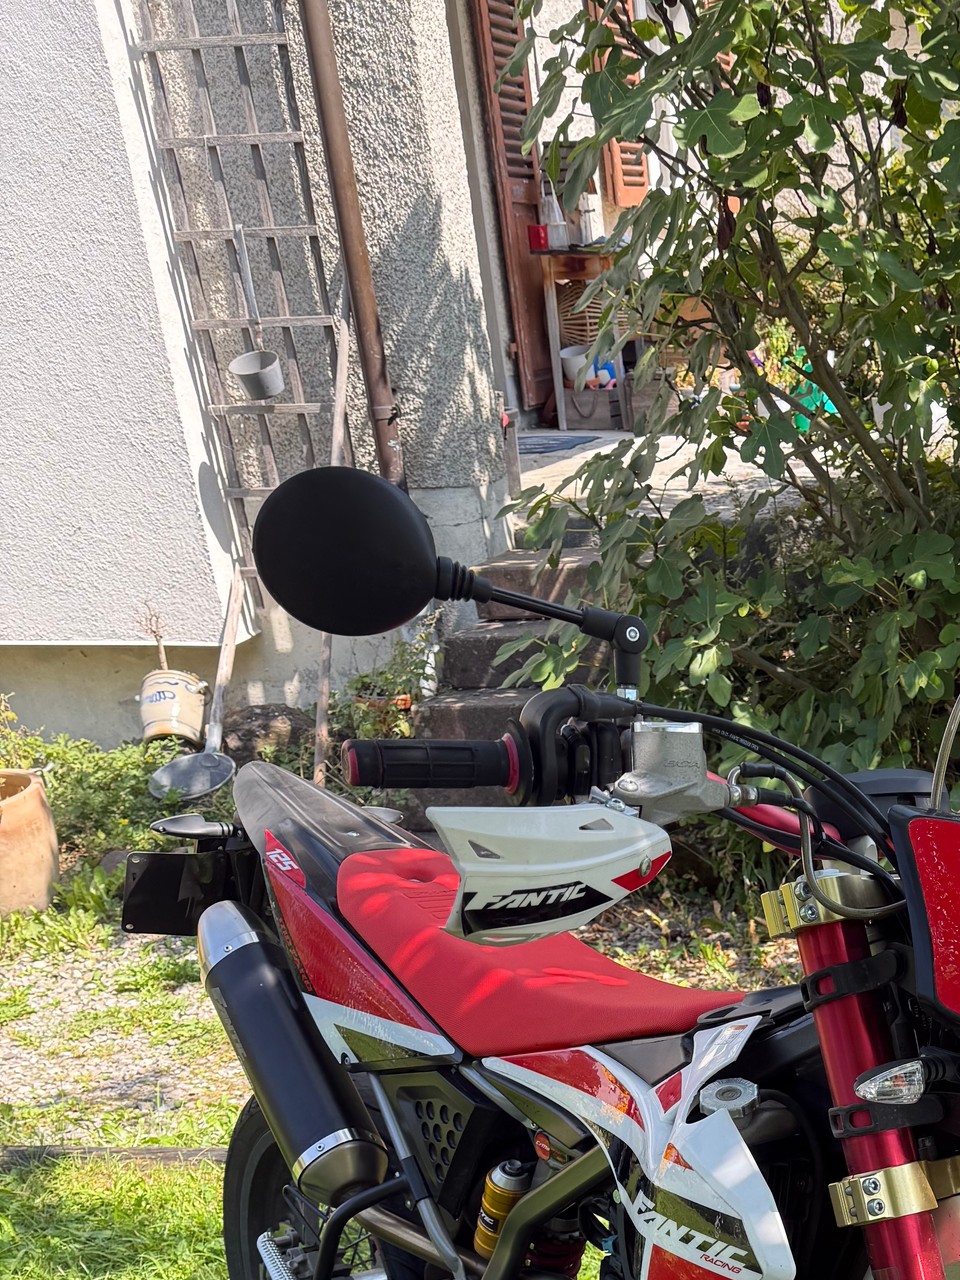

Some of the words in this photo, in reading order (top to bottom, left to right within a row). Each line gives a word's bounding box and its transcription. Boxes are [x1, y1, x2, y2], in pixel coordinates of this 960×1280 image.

[266, 848, 299, 871] 125
[464, 883, 588, 911] FANTIC
[632, 1189, 749, 1268] FANTIC
[700, 1254, 742, 1274] RACING
